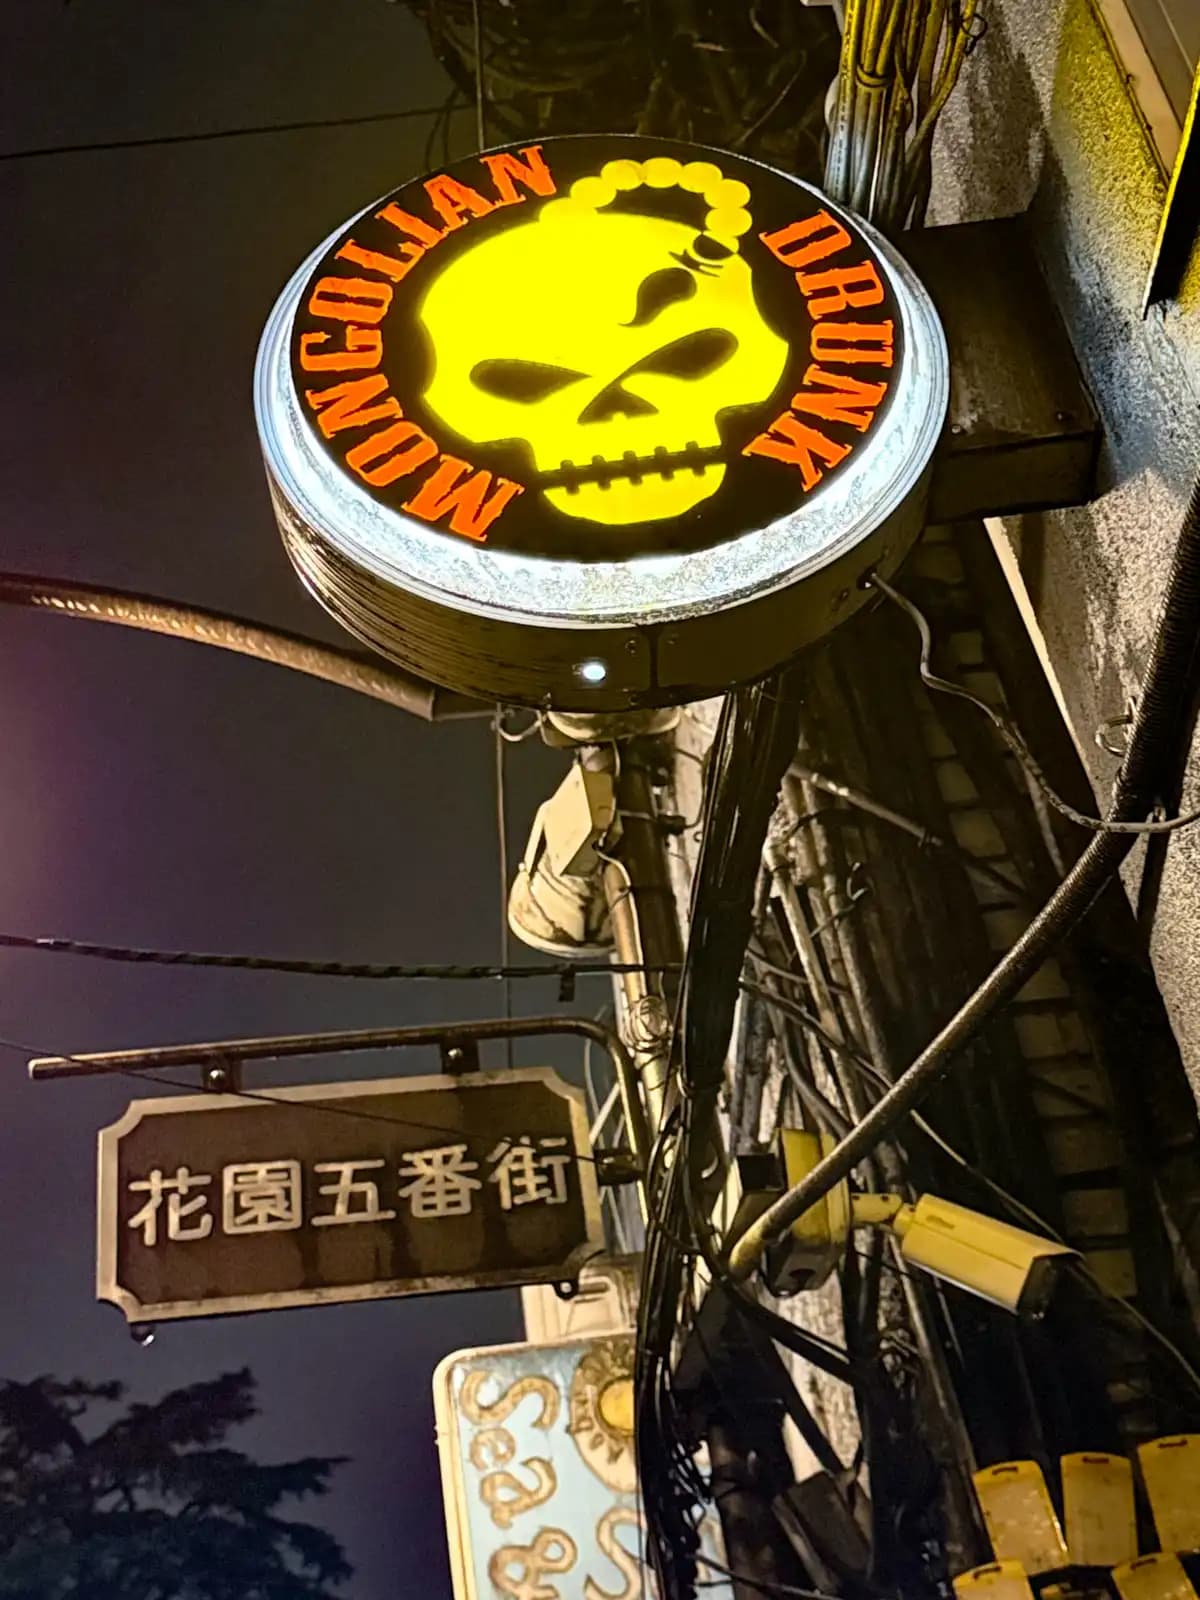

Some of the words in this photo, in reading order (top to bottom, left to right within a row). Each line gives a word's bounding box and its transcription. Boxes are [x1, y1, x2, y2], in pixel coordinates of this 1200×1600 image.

[300, 145, 556, 541] MONGOLIAN
[743, 210, 895, 491] DRUNK
[128, 1136, 571, 1246] 花園五番街
[459, 1370, 561, 1528] Sea
